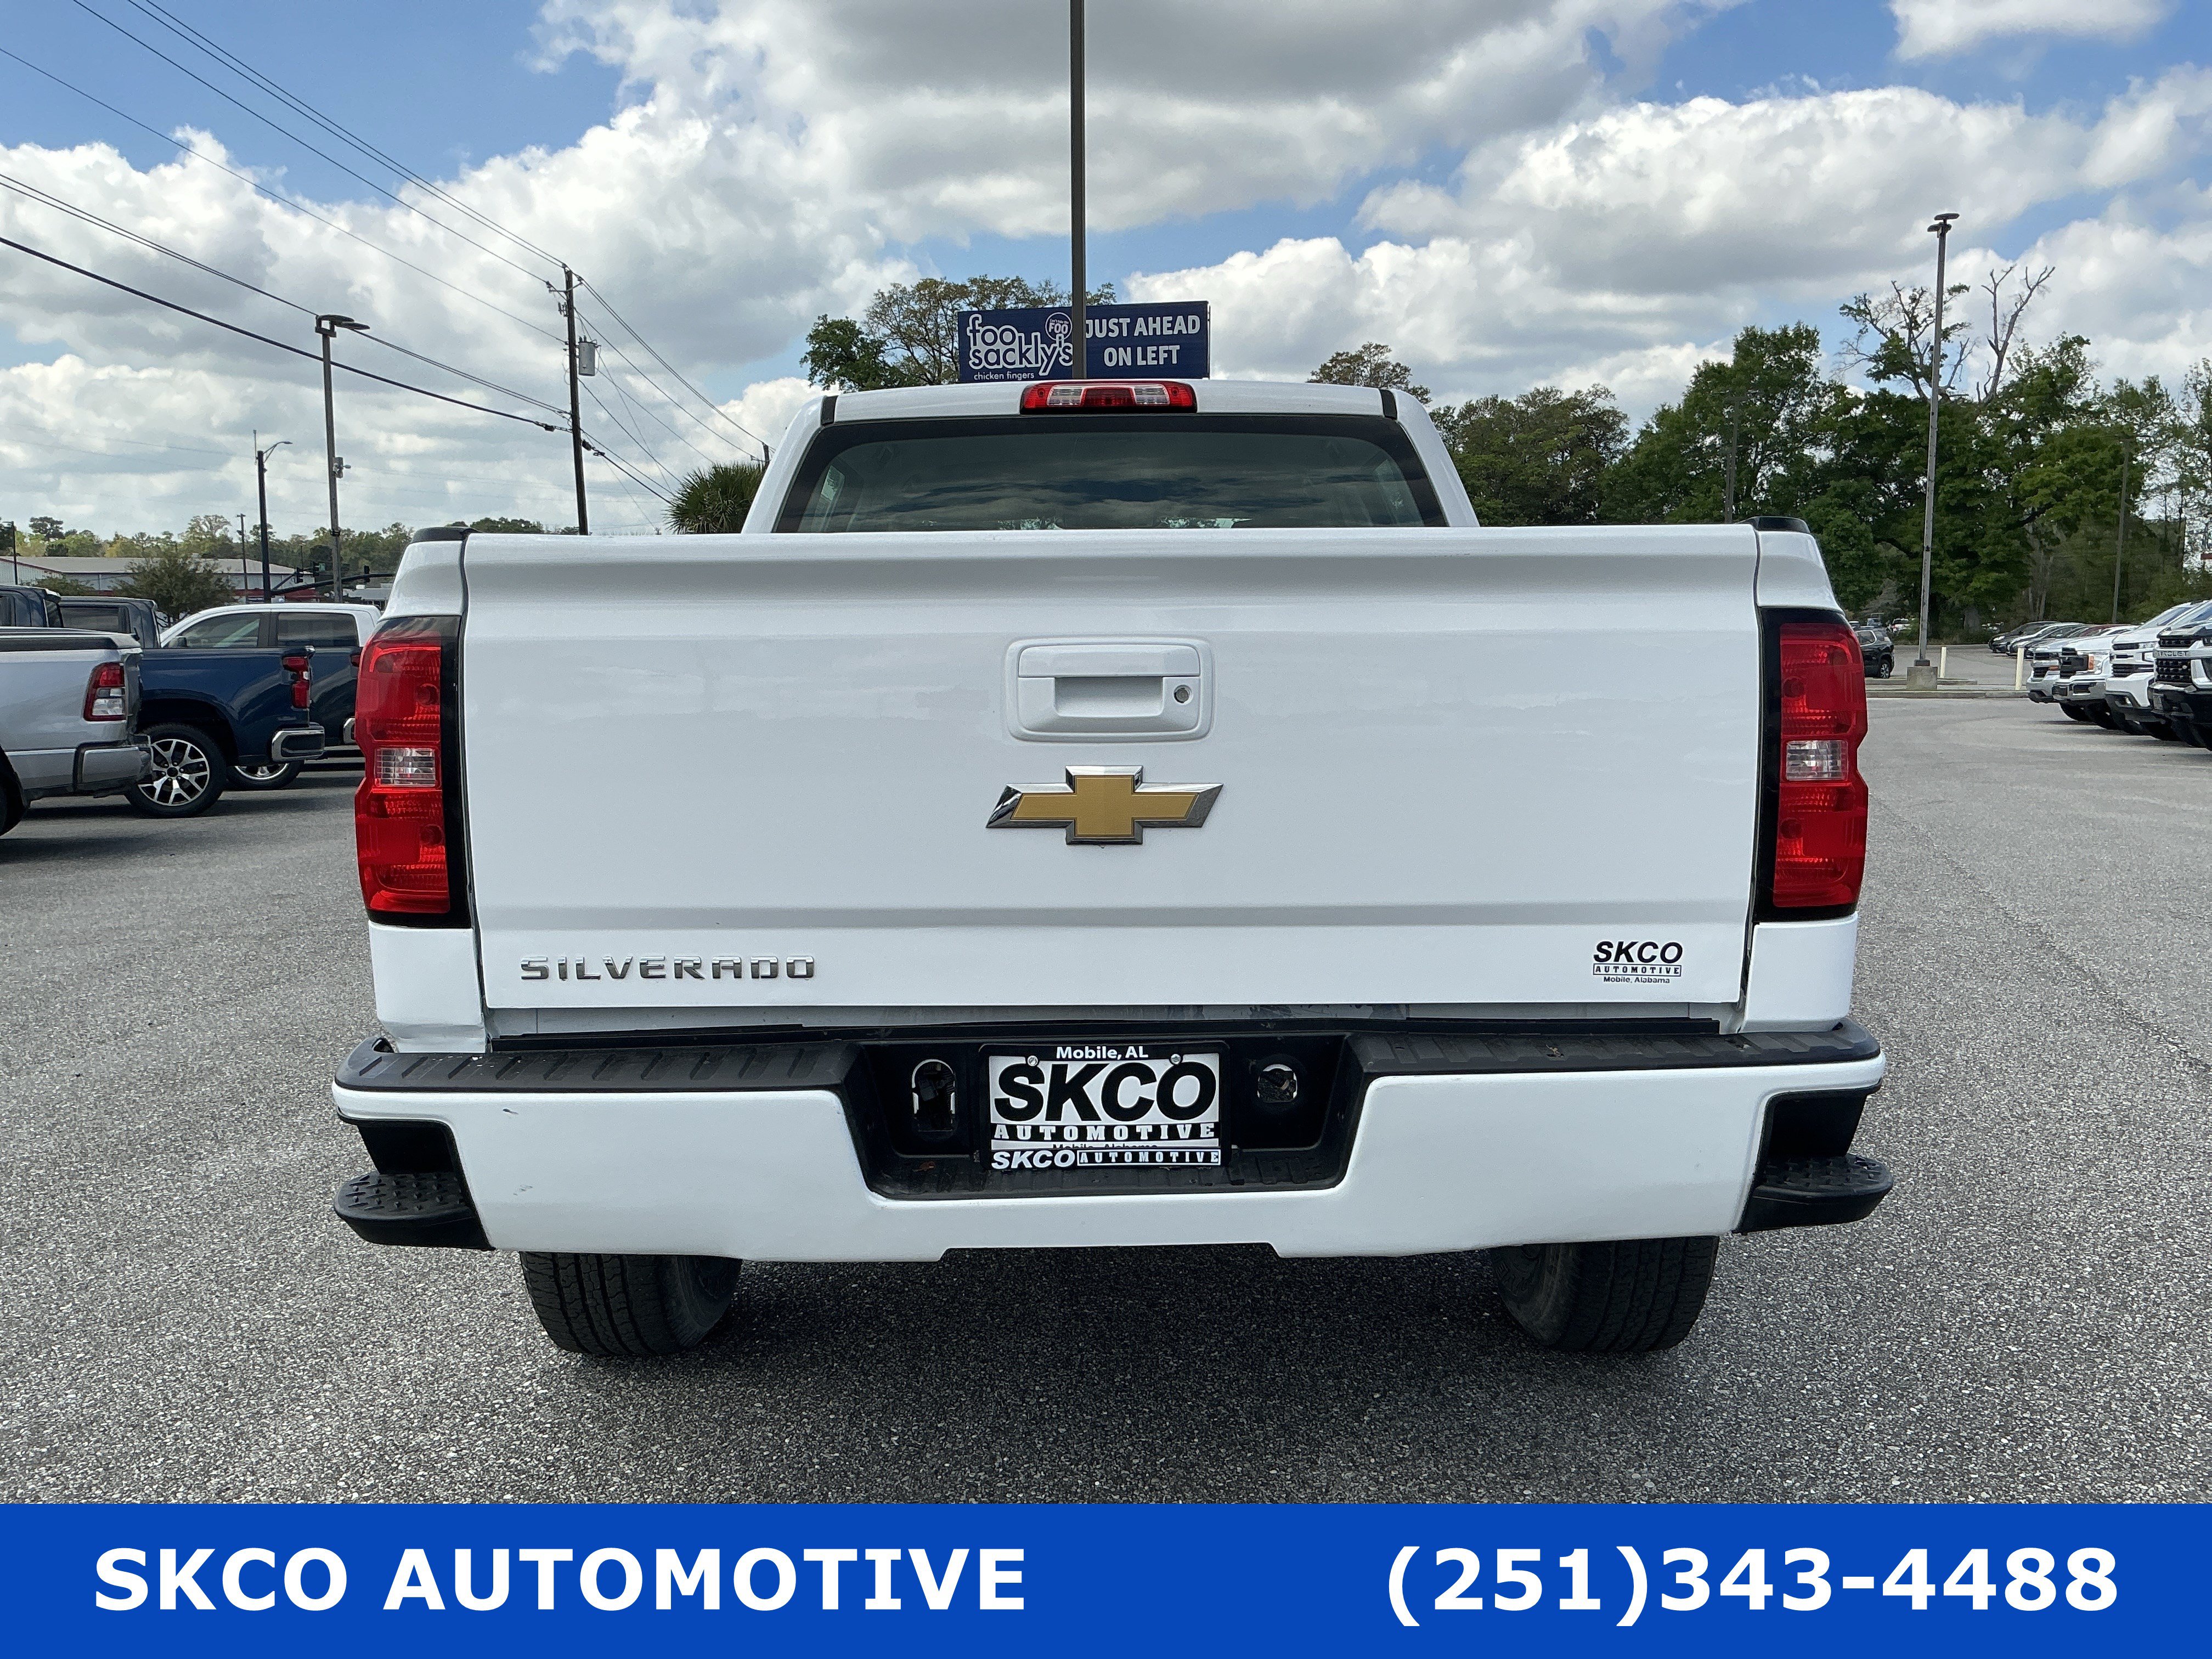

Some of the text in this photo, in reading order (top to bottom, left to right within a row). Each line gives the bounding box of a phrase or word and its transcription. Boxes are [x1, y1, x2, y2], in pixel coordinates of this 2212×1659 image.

[968, 315, 1017, 347] foo
[1049, 322, 1068, 334] FOO
[1086, 315, 1200, 338] JUST AHEAD
[970, 334, 1073, 374] sackly's
[1104, 345, 1180, 367] ON LEFT
[974, 370, 1035, 381] chicken fingers
[1593, 941, 1683, 964] SKCO
[521, 956, 815, 980] SILVERADO
[1595, 966, 1680, 974] AUTOMOTIVE
[1056, 1046, 1149, 1060] Mobile, AL
[994, 1062, 1216, 1122] SKCO
[994, 1122, 1215, 1141] AUTOMOTIVE
[991, 1150, 1219, 1169] SKCO AUTOMOTIVE
